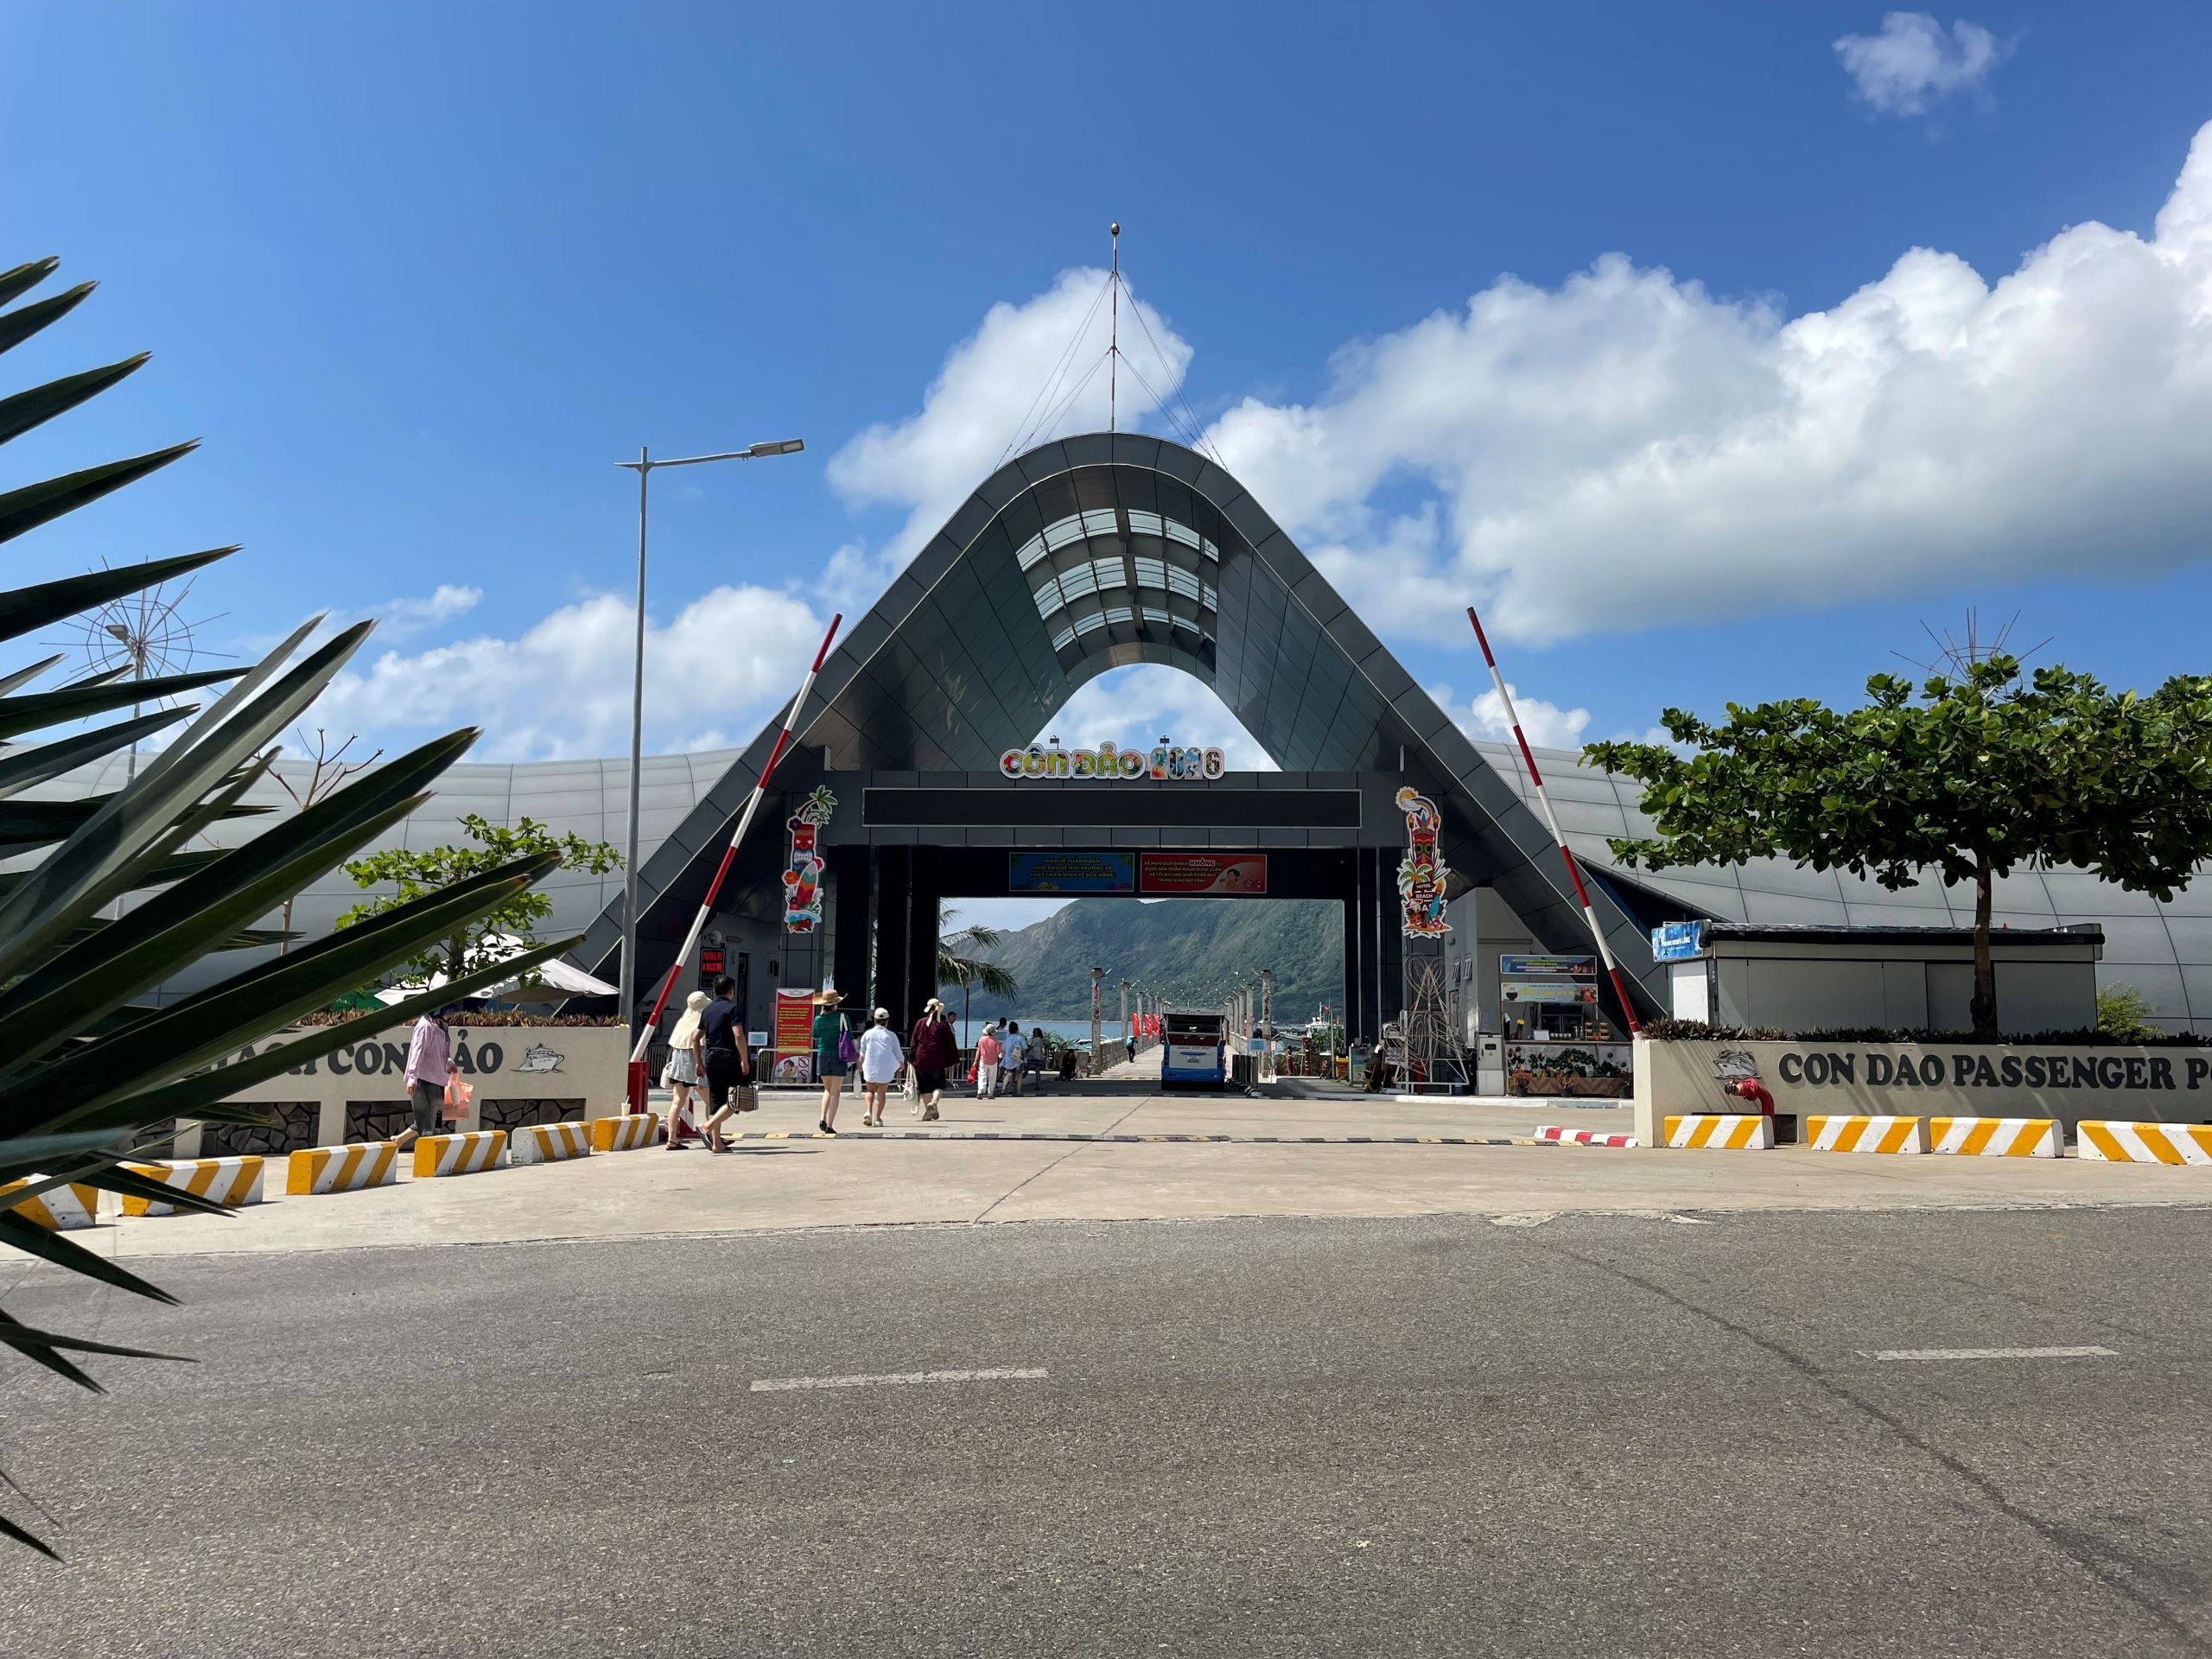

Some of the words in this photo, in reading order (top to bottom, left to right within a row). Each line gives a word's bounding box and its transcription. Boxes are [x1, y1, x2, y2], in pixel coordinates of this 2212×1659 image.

[1150, 747, 1224, 779] 2026
[1778, 1052, 1855, 1084] CON
[1866, 1053, 1945, 1086] DAO
[1952, 1054, 2177, 1090] PASSENGER
[2185, 1058, 2212, 1090] P
